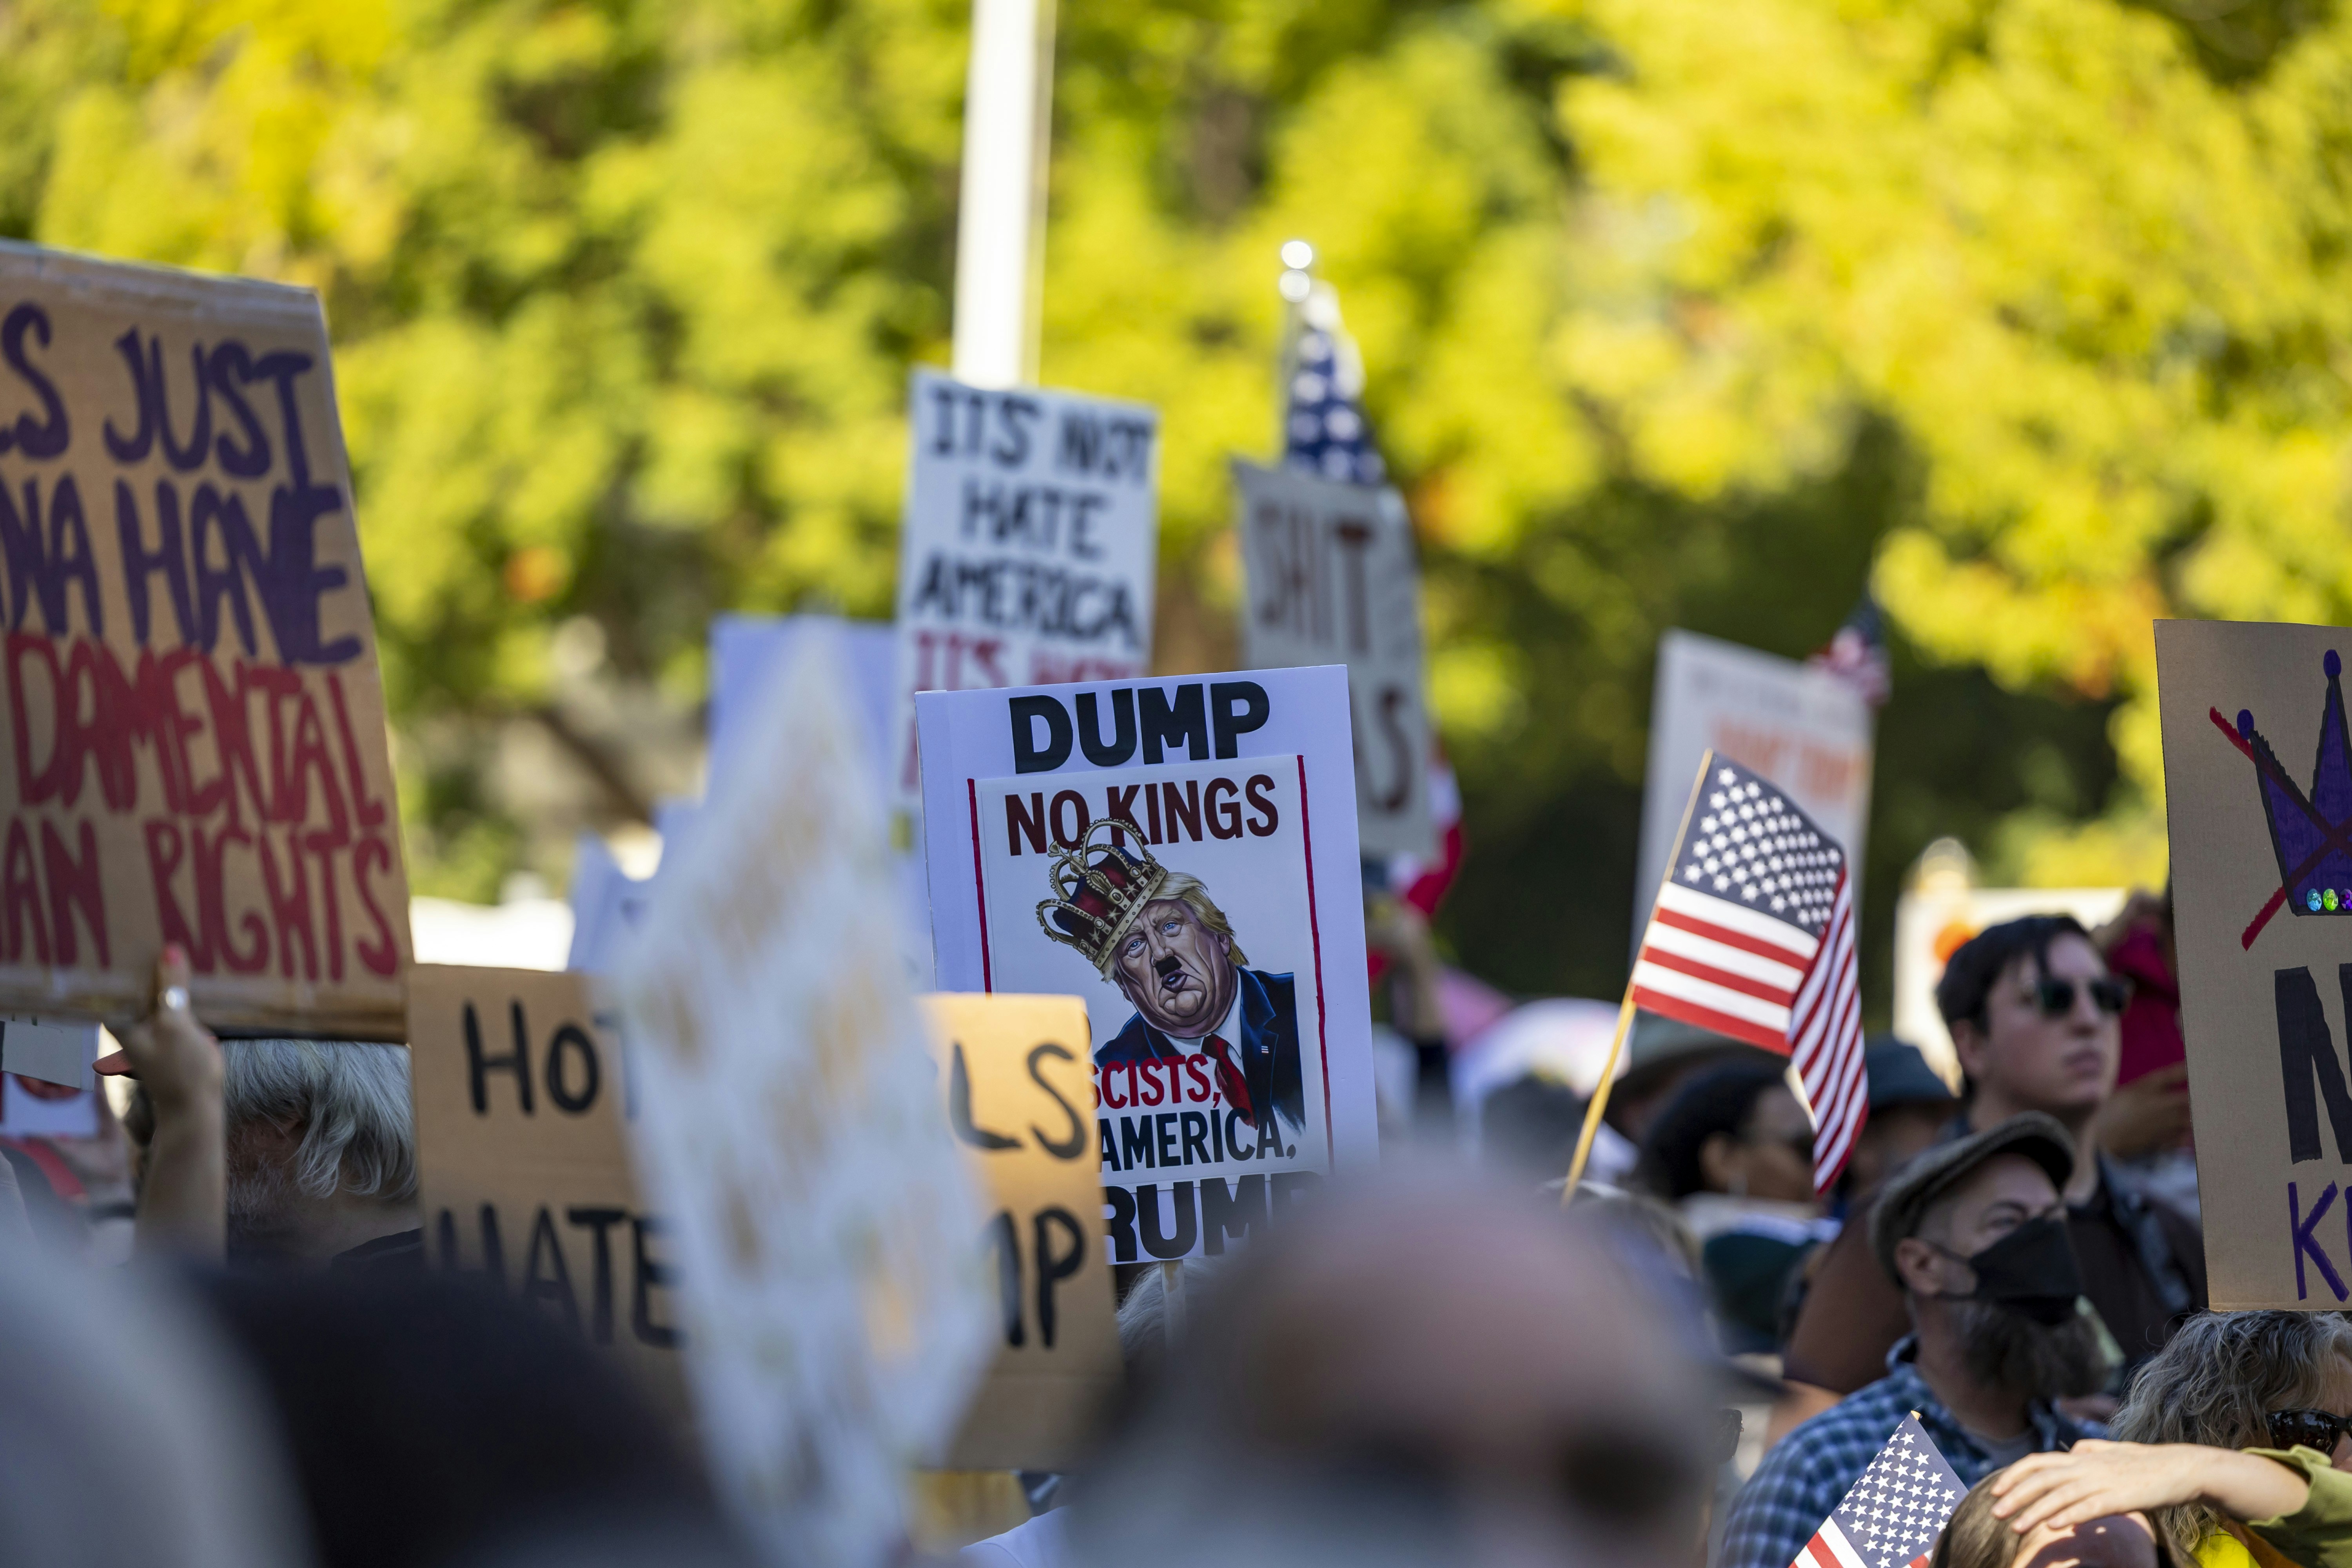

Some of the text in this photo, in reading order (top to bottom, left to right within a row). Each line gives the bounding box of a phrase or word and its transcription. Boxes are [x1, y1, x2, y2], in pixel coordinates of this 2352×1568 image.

[103, 325, 313, 483] JUST
[960, 476, 1111, 561] HATE
[114, 476, 363, 666] HAVE
[910, 551, 1143, 652] AMERICA
[7, 633, 386, 839] DAMENTAL
[1009, 681, 1270, 774] DUMP
[1005, 774, 1279, 856] NO KINGS
[143, 816, 398, 984] RIGHTS
[1098, 1107, 1297, 1173] AMERICA,
